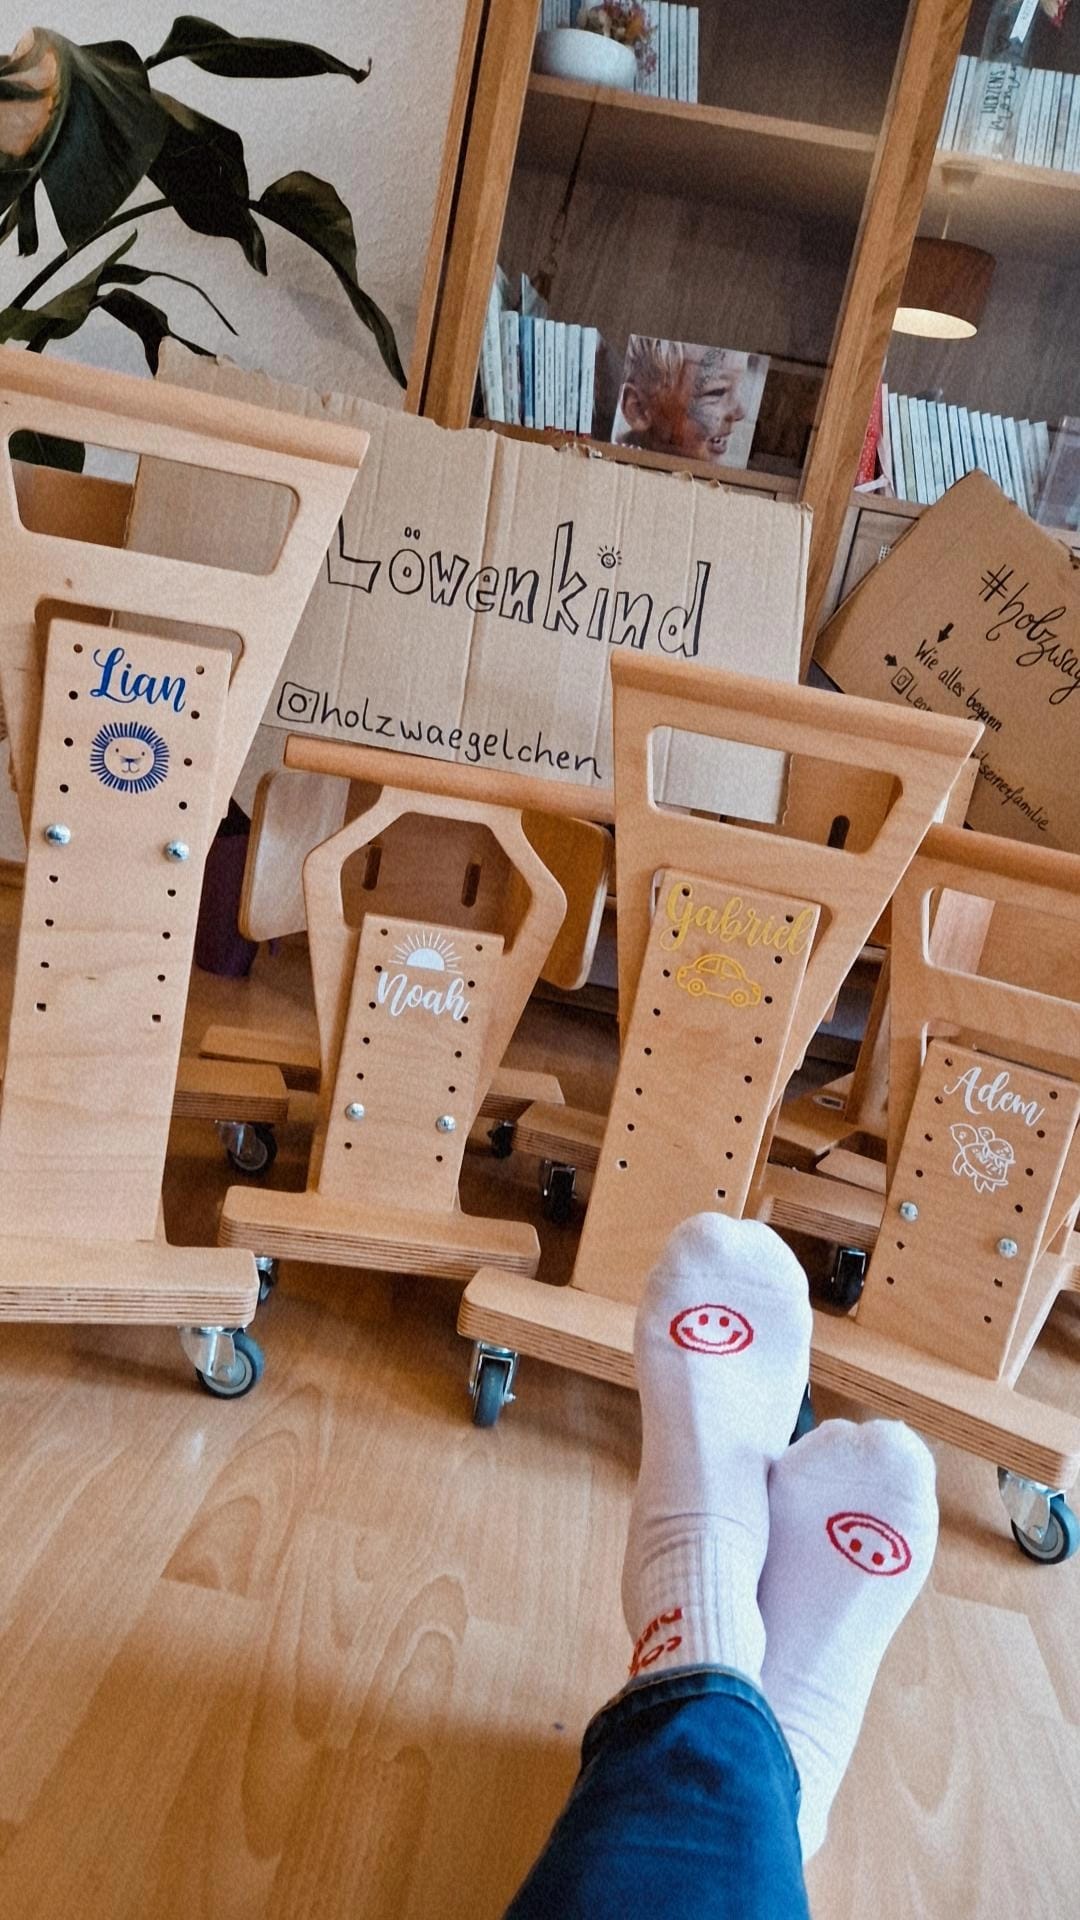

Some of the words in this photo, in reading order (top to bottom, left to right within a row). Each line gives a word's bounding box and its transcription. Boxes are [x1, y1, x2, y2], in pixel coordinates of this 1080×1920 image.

[326, 514, 711, 658] Löwenkind
[89, 647, 186, 713] Lian
[914, 638, 939, 671] Wie
[937, 665, 966, 698] alles
[965, 687, 1003, 732] begann
[318, 691, 602, 780] holzwaegelchen
[659, 881, 815, 956] Gabriel
[377, 971, 471, 1022] Noah
[943, 1066, 1046, 1127] Adem
